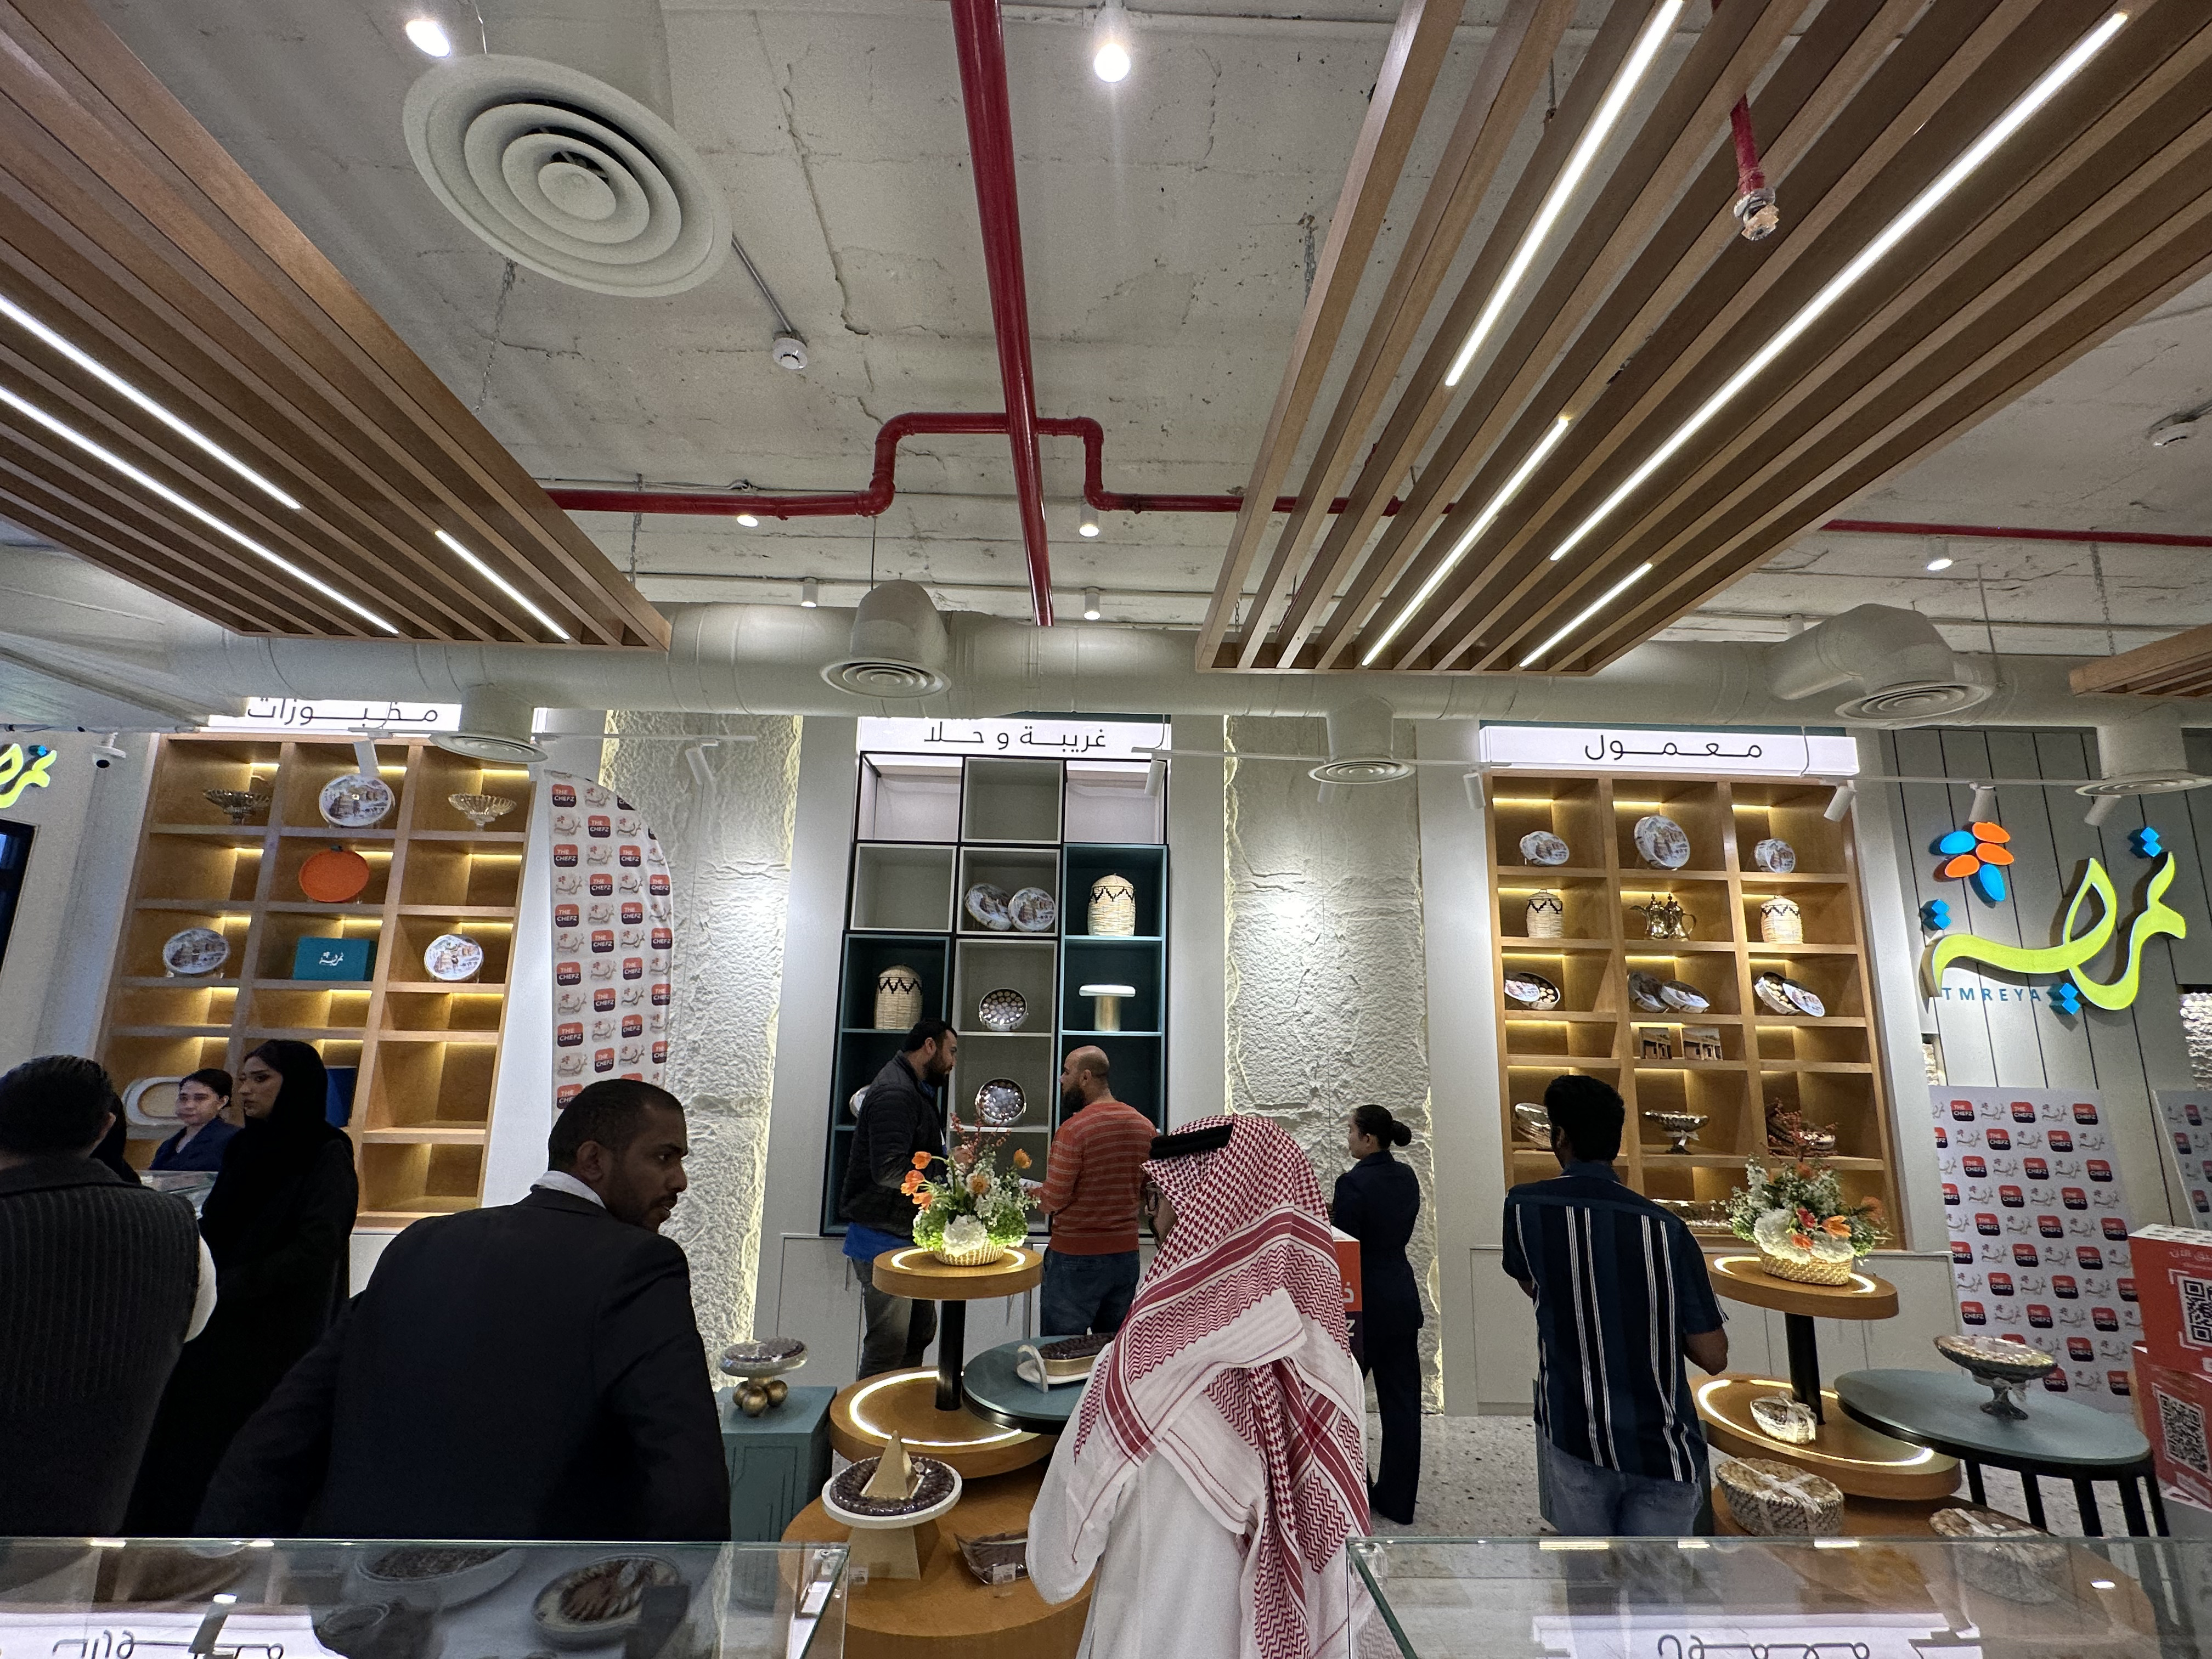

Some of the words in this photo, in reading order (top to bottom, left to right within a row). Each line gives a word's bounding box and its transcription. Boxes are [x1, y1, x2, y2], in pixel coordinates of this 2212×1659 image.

[924, 721, 984, 743] حلا
[997, 731, 1008, 750] و
[1020, 725, 1105, 753] غريبة
[1585, 735, 1762, 760] معمول
[1943, 988, 2041, 1002] TMREYA
